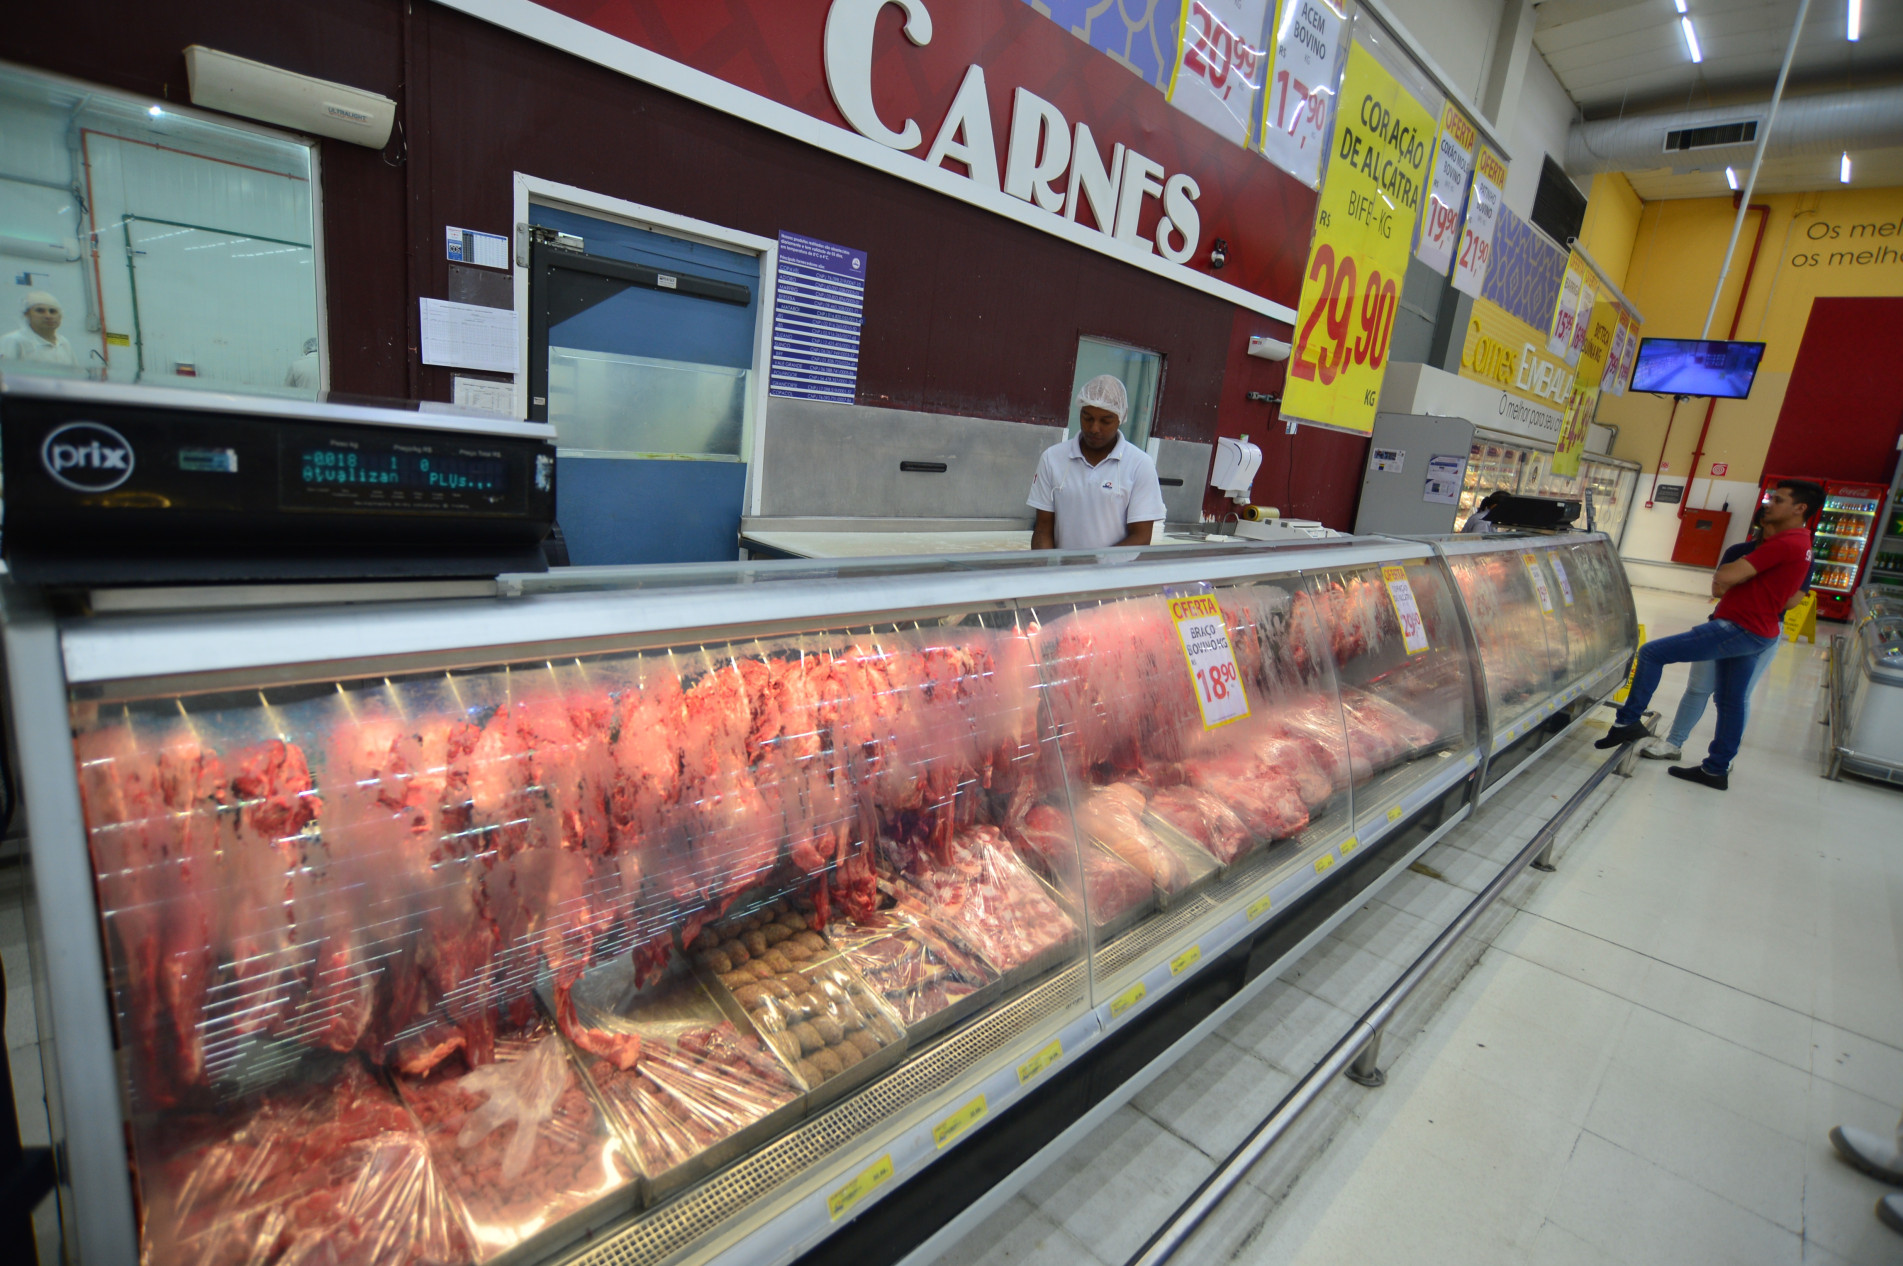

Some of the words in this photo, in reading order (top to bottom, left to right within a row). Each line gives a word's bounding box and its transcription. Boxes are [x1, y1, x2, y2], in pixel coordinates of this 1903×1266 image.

[1301, 2, 1325, 36] ACEM
[1293, 21, 1326, 61] BOVINO
[824, 0, 1201, 265] CARNES
[1361, 94, 1424, 170] CORAÇÃO
[1445, 106, 1475, 154] OFERTA
[1340, 126, 1362, 169] DE
[1361, 145, 1419, 213] ALCATRA
[1480, 150, 1506, 190] OFERTA
[1319, 210, 1331, 228] R$
[1806, 222, 1842, 240] Os
[1791, 253, 1821, 268] os
[1828, 246, 1903, 266] melh
[1291, 243, 1396, 386] 29,90
[1461, 315, 1517, 384] Carnes
[1364, 388, 1377, 407] KG
[1499, 394, 1507, 415] O
[1506, 400, 1531, 422] melhor
[53, 440, 128, 472] prix
[1172, 597, 1217, 620] OFERTA
[1190, 624, 1216, 640] BRAÇO
[1196, 661, 1237, 703] 18,90
